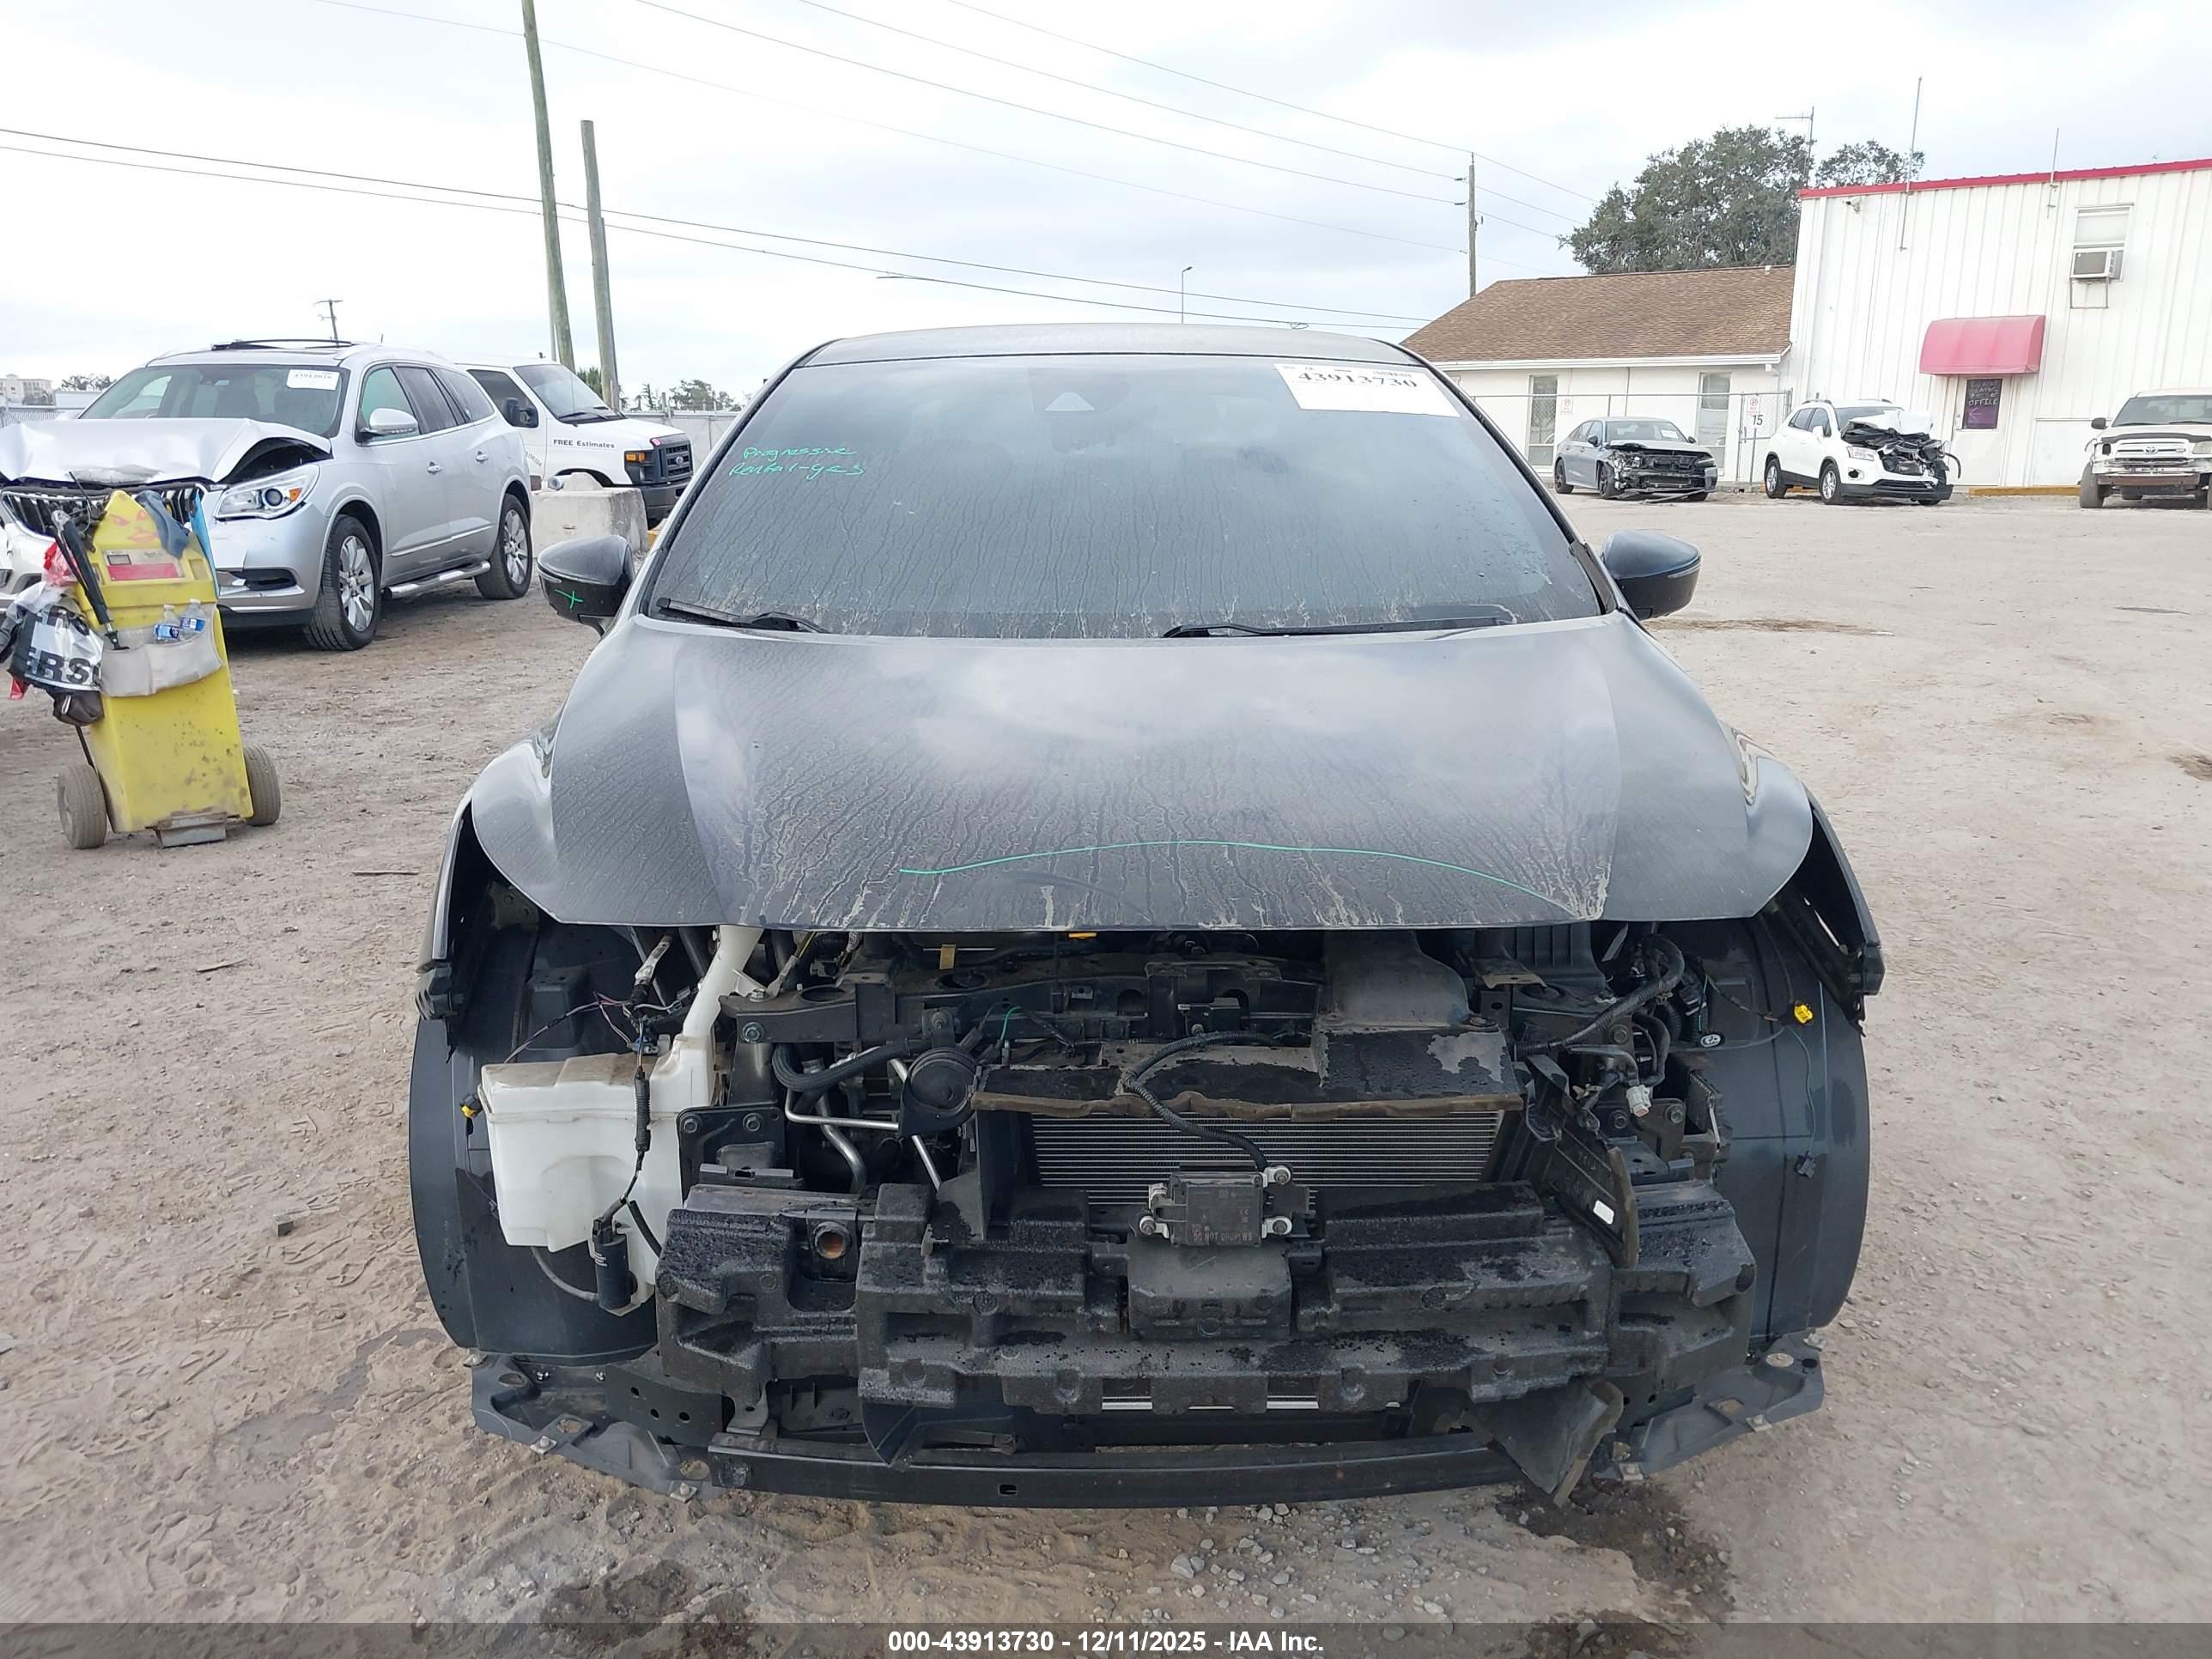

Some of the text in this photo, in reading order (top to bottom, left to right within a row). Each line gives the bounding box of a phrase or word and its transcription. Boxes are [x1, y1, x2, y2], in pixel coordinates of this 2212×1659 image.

[1297, 372, 1418, 387] 43913730
[1752, 414, 1764, 426] 15
[576, 440, 615, 449] Estimates
